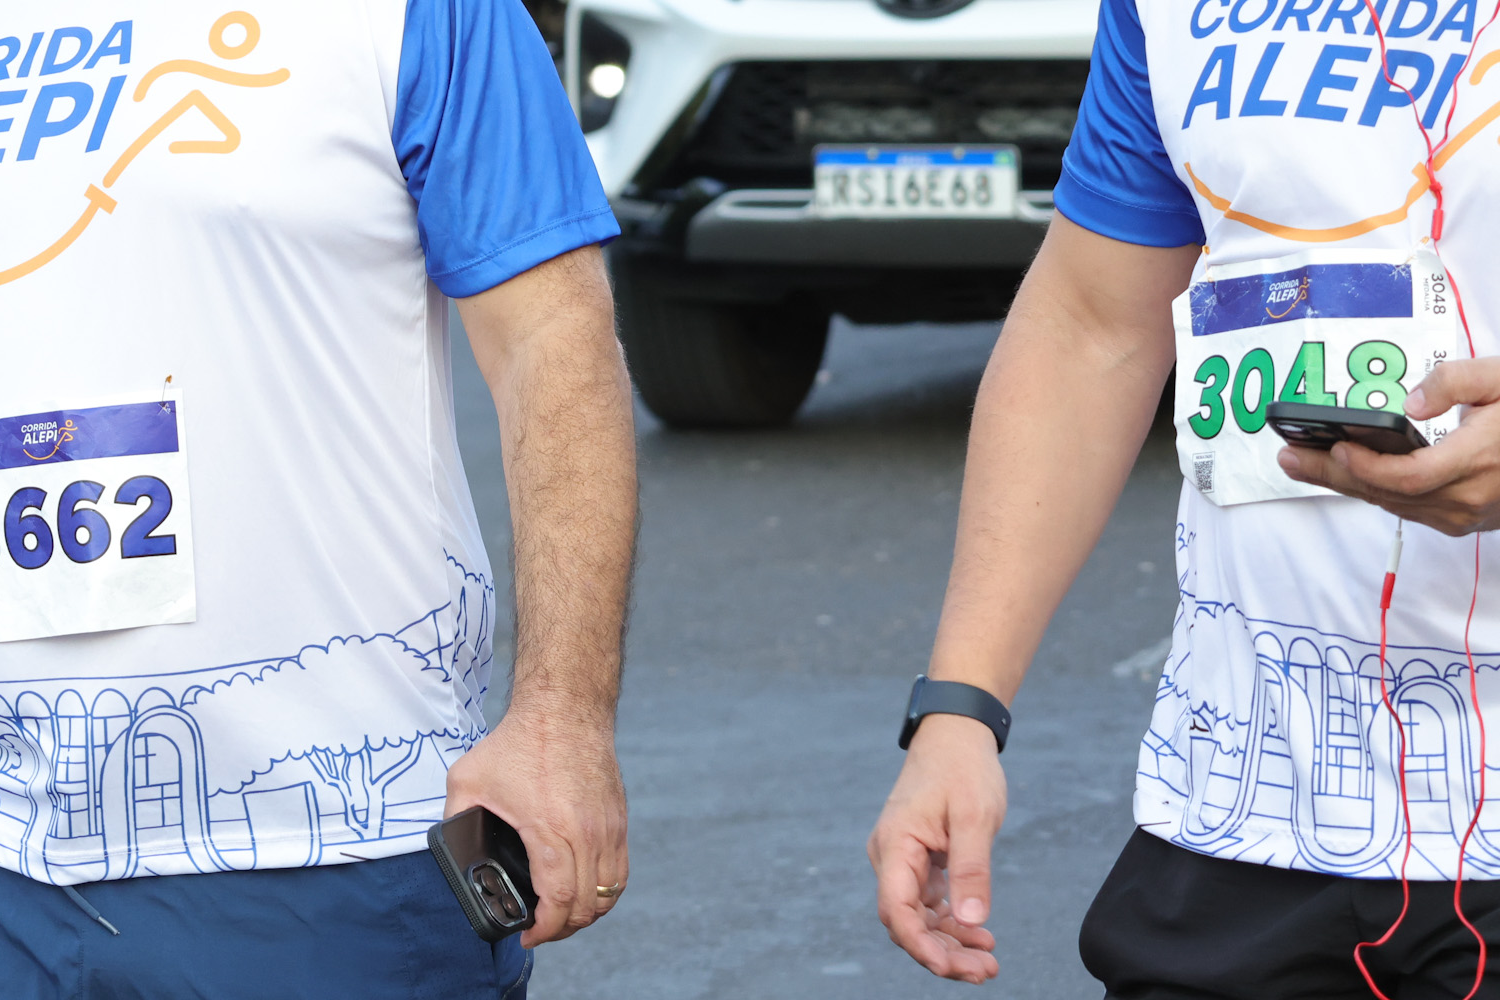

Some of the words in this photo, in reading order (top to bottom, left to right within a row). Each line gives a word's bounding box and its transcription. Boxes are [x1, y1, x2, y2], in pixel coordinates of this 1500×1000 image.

[1181, 41, 1468, 130] ALEPI
[1269, 279, 1299, 291] CORRIDA
[1266, 288, 1299, 303] ALEPI
[1431, 273, 1446, 314] 3048
[1188, 340, 1409, 439] 3048
[21, 421, 57, 433] CORRIDA
[23, 430, 58, 445] ALEPI
